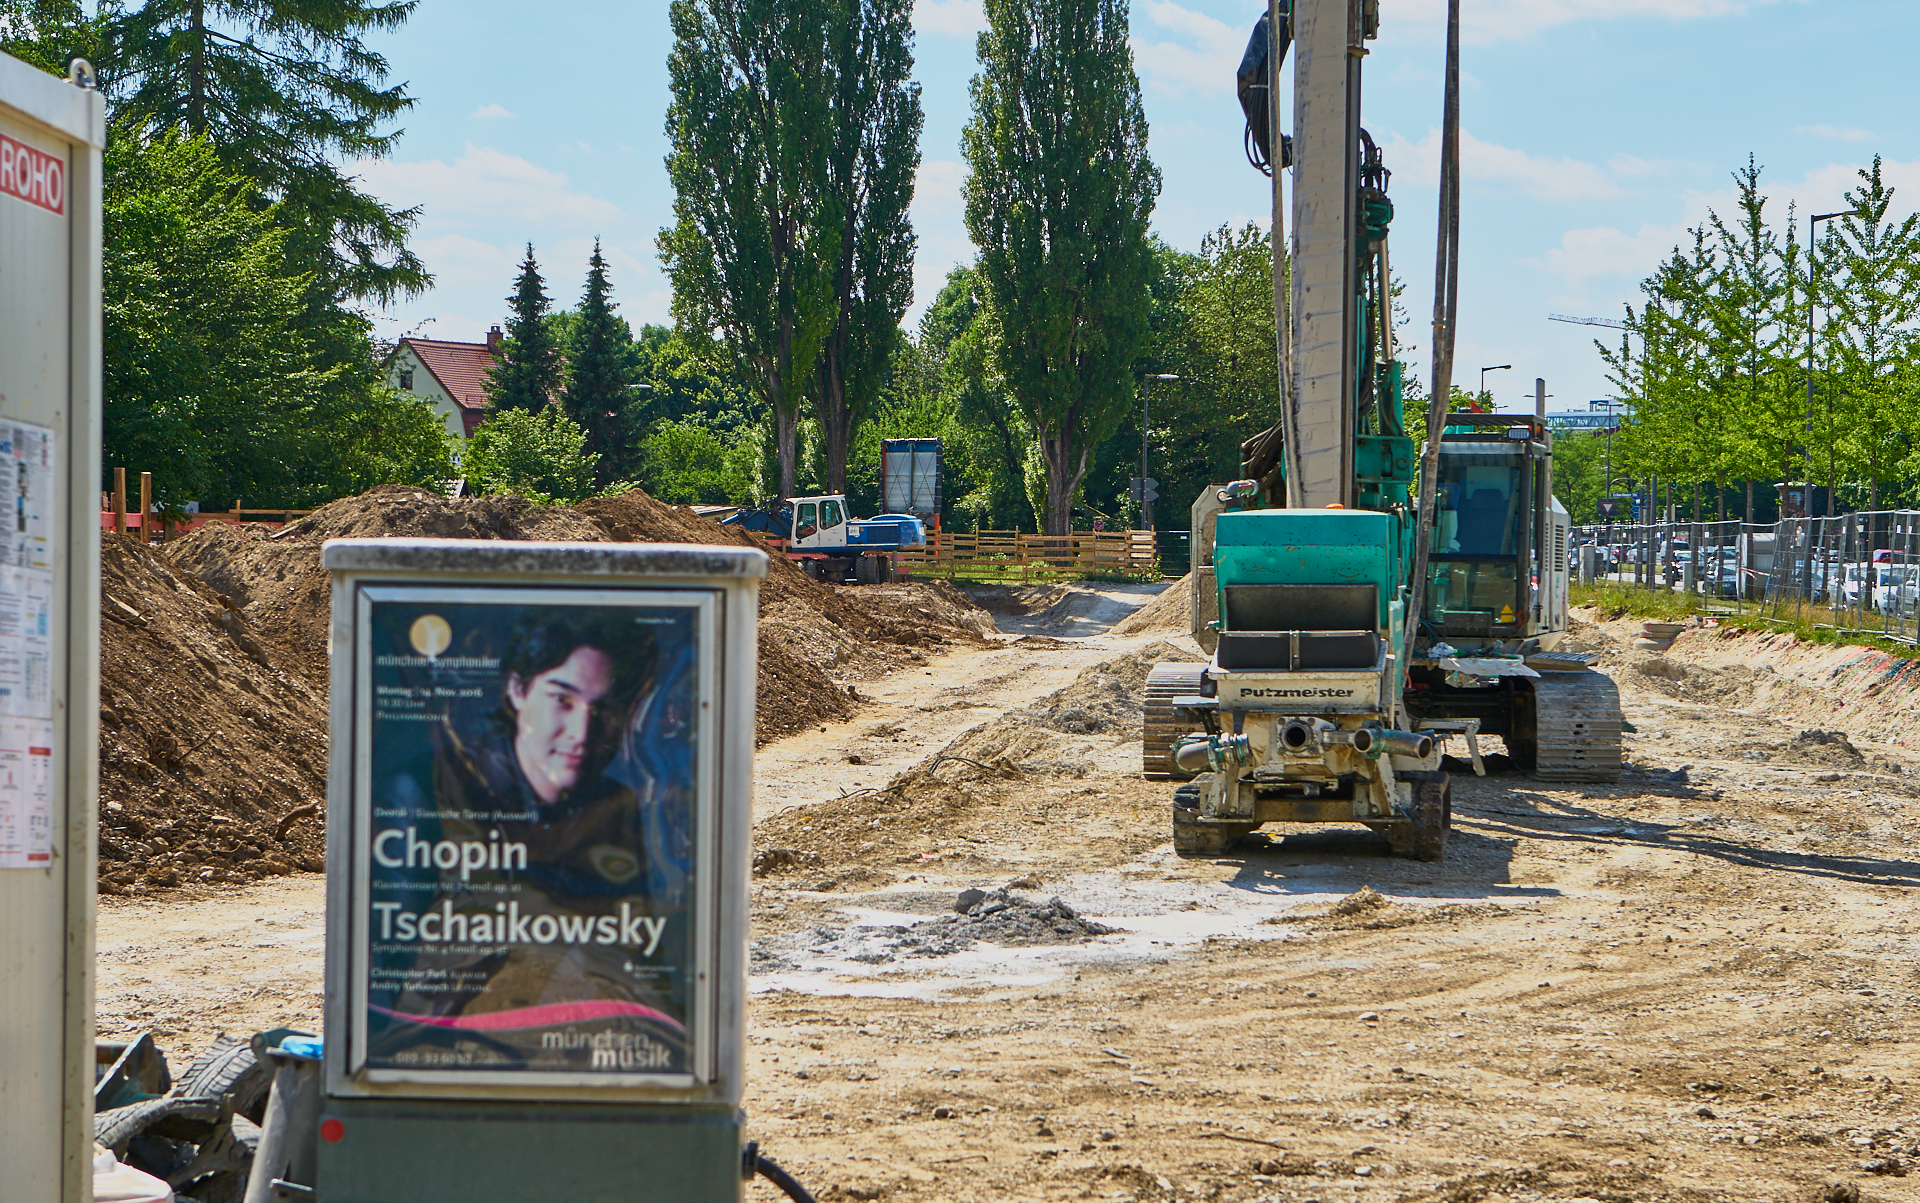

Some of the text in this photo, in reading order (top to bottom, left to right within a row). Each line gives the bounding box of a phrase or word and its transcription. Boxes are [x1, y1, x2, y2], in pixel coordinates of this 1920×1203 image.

[1, 140, 62, 210] ROHO
[434, 654, 501, 670] symphoniker
[376, 685, 413, 698] Montag
[1240, 687, 1354, 698] Putzmeister
[373, 826, 527, 882] Chopin
[372, 900, 667, 957] Tschaikowsky
[541, 1026, 649, 1049] münchen
